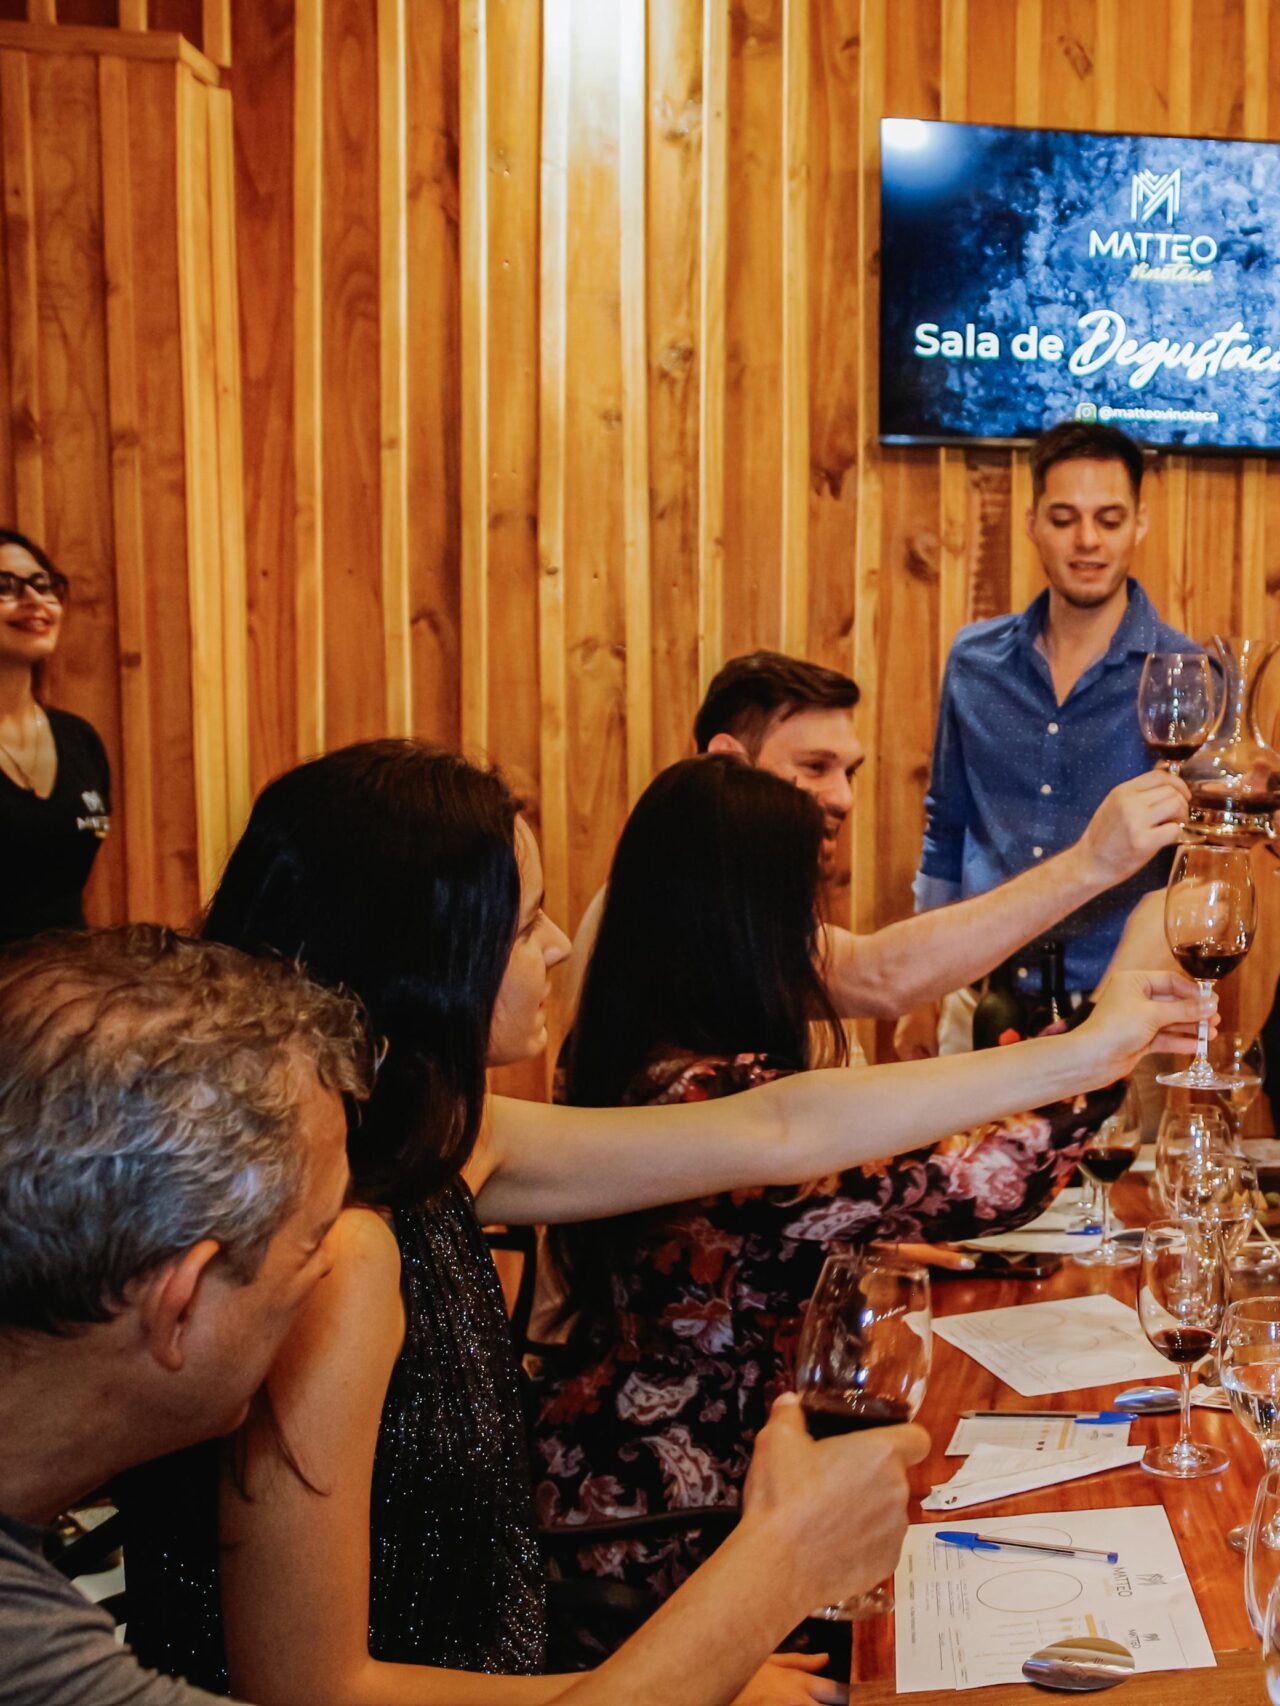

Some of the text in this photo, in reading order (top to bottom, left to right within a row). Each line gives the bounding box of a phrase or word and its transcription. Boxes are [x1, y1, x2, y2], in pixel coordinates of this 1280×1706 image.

[1089, 229, 1218, 264] MATTEO
[914, 323, 1000, 360] Sala
[1011, 325, 1065, 361] de
[1099, 405, 1219, 424] @matteovinoteca
